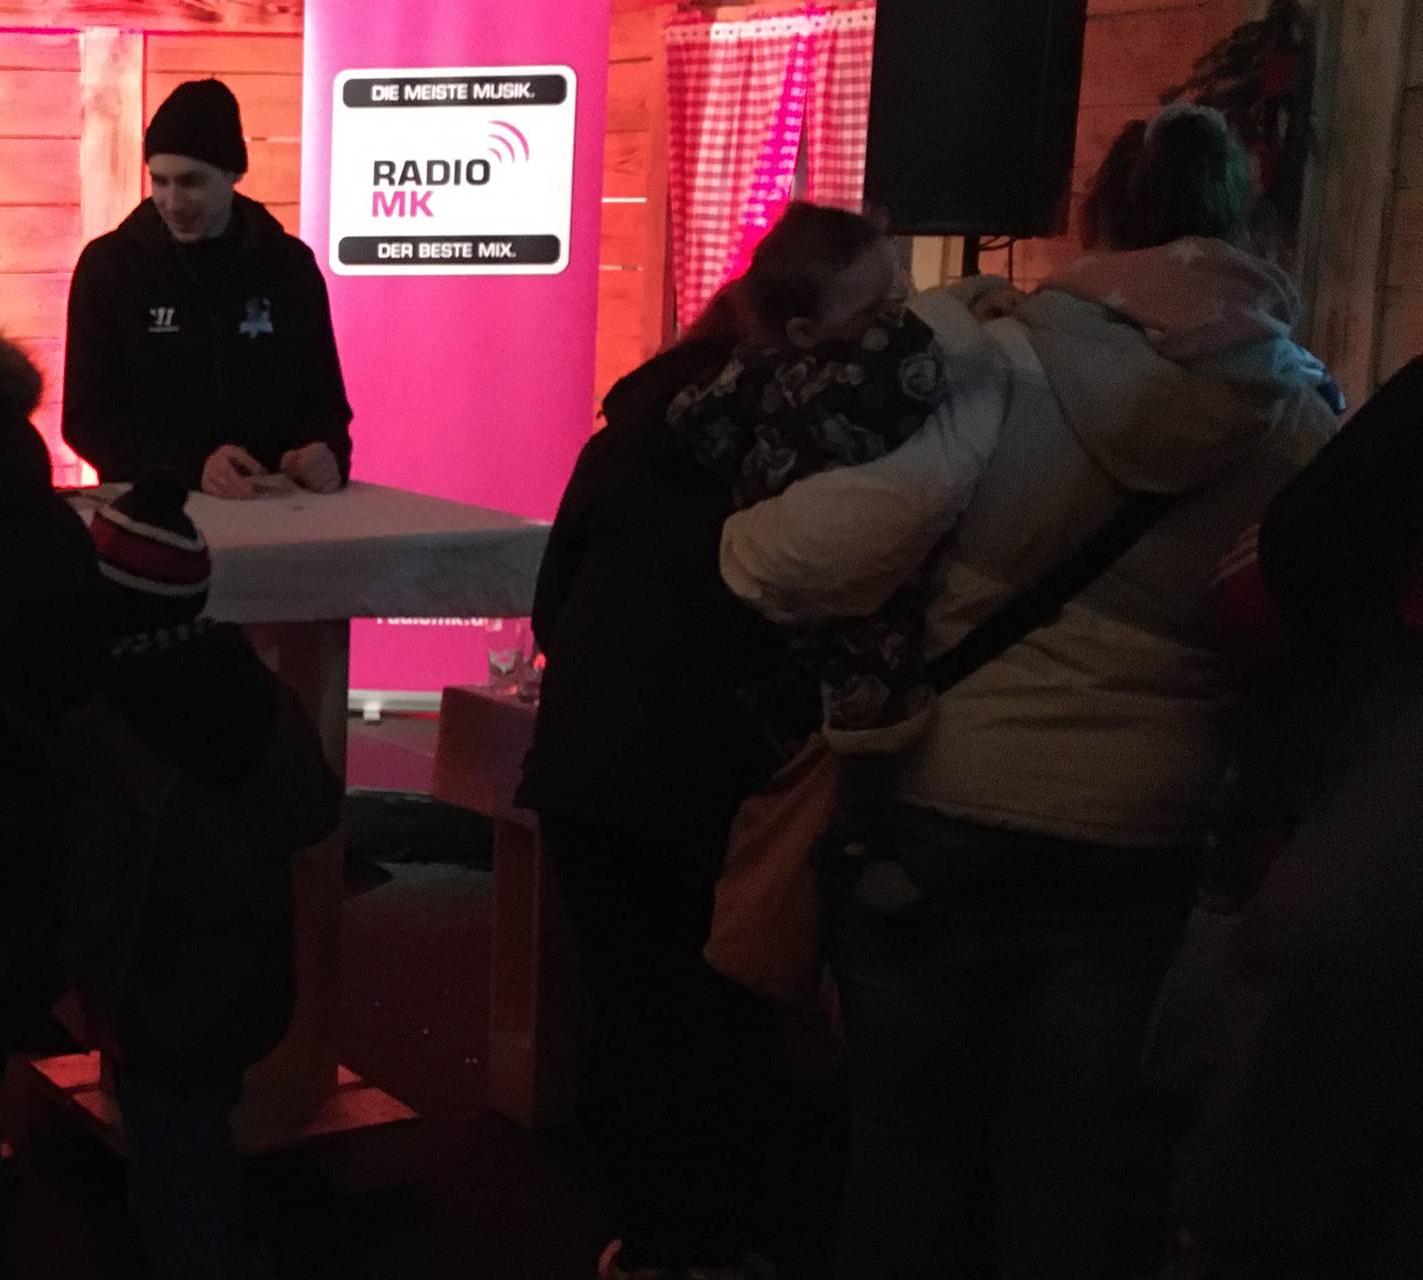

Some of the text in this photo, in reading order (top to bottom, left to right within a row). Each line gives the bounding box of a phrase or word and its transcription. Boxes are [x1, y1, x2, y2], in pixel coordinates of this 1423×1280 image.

[371, 82, 536, 101] DIE MEISTE MUSIK.
[373, 159, 492, 187] RADIO
[371, 190, 435, 218] MK
[377, 242, 517, 259] DER BESTE MIX.
